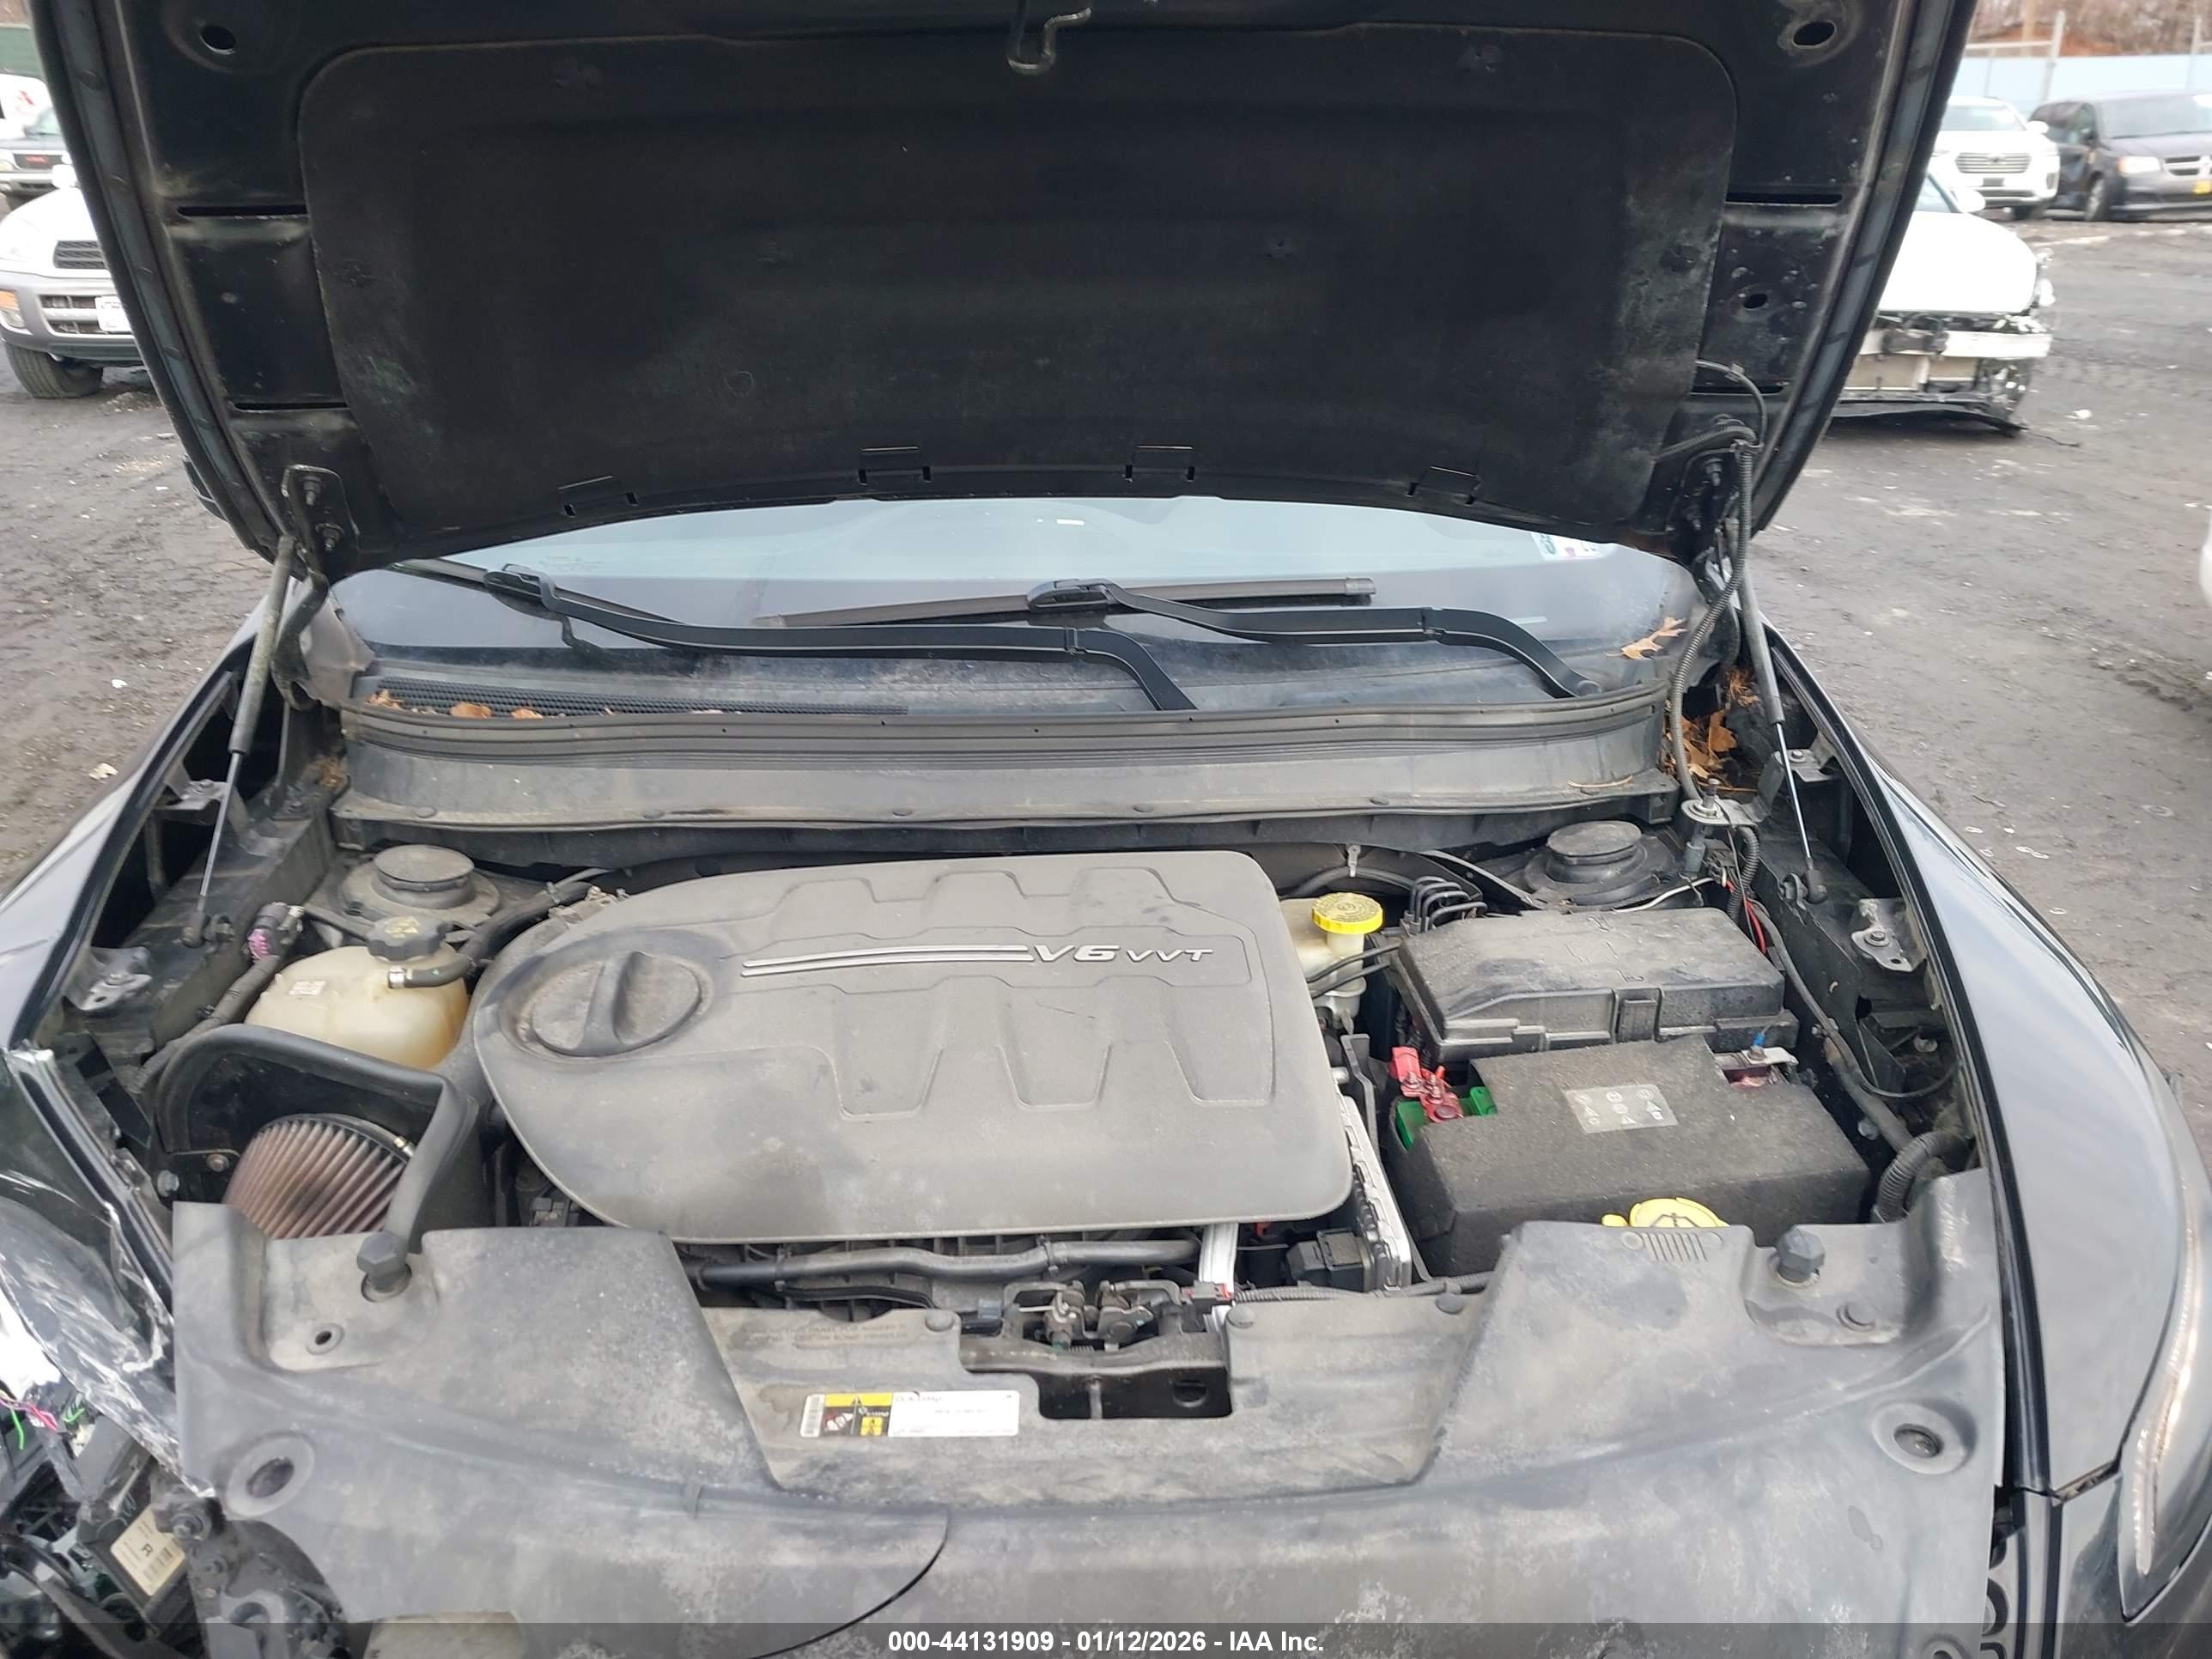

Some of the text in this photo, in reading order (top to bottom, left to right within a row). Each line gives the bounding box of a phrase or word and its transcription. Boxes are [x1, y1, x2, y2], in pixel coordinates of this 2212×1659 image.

[1034, 945, 1214, 963] V6 VVT
[142, 1543, 153, 1556] R
